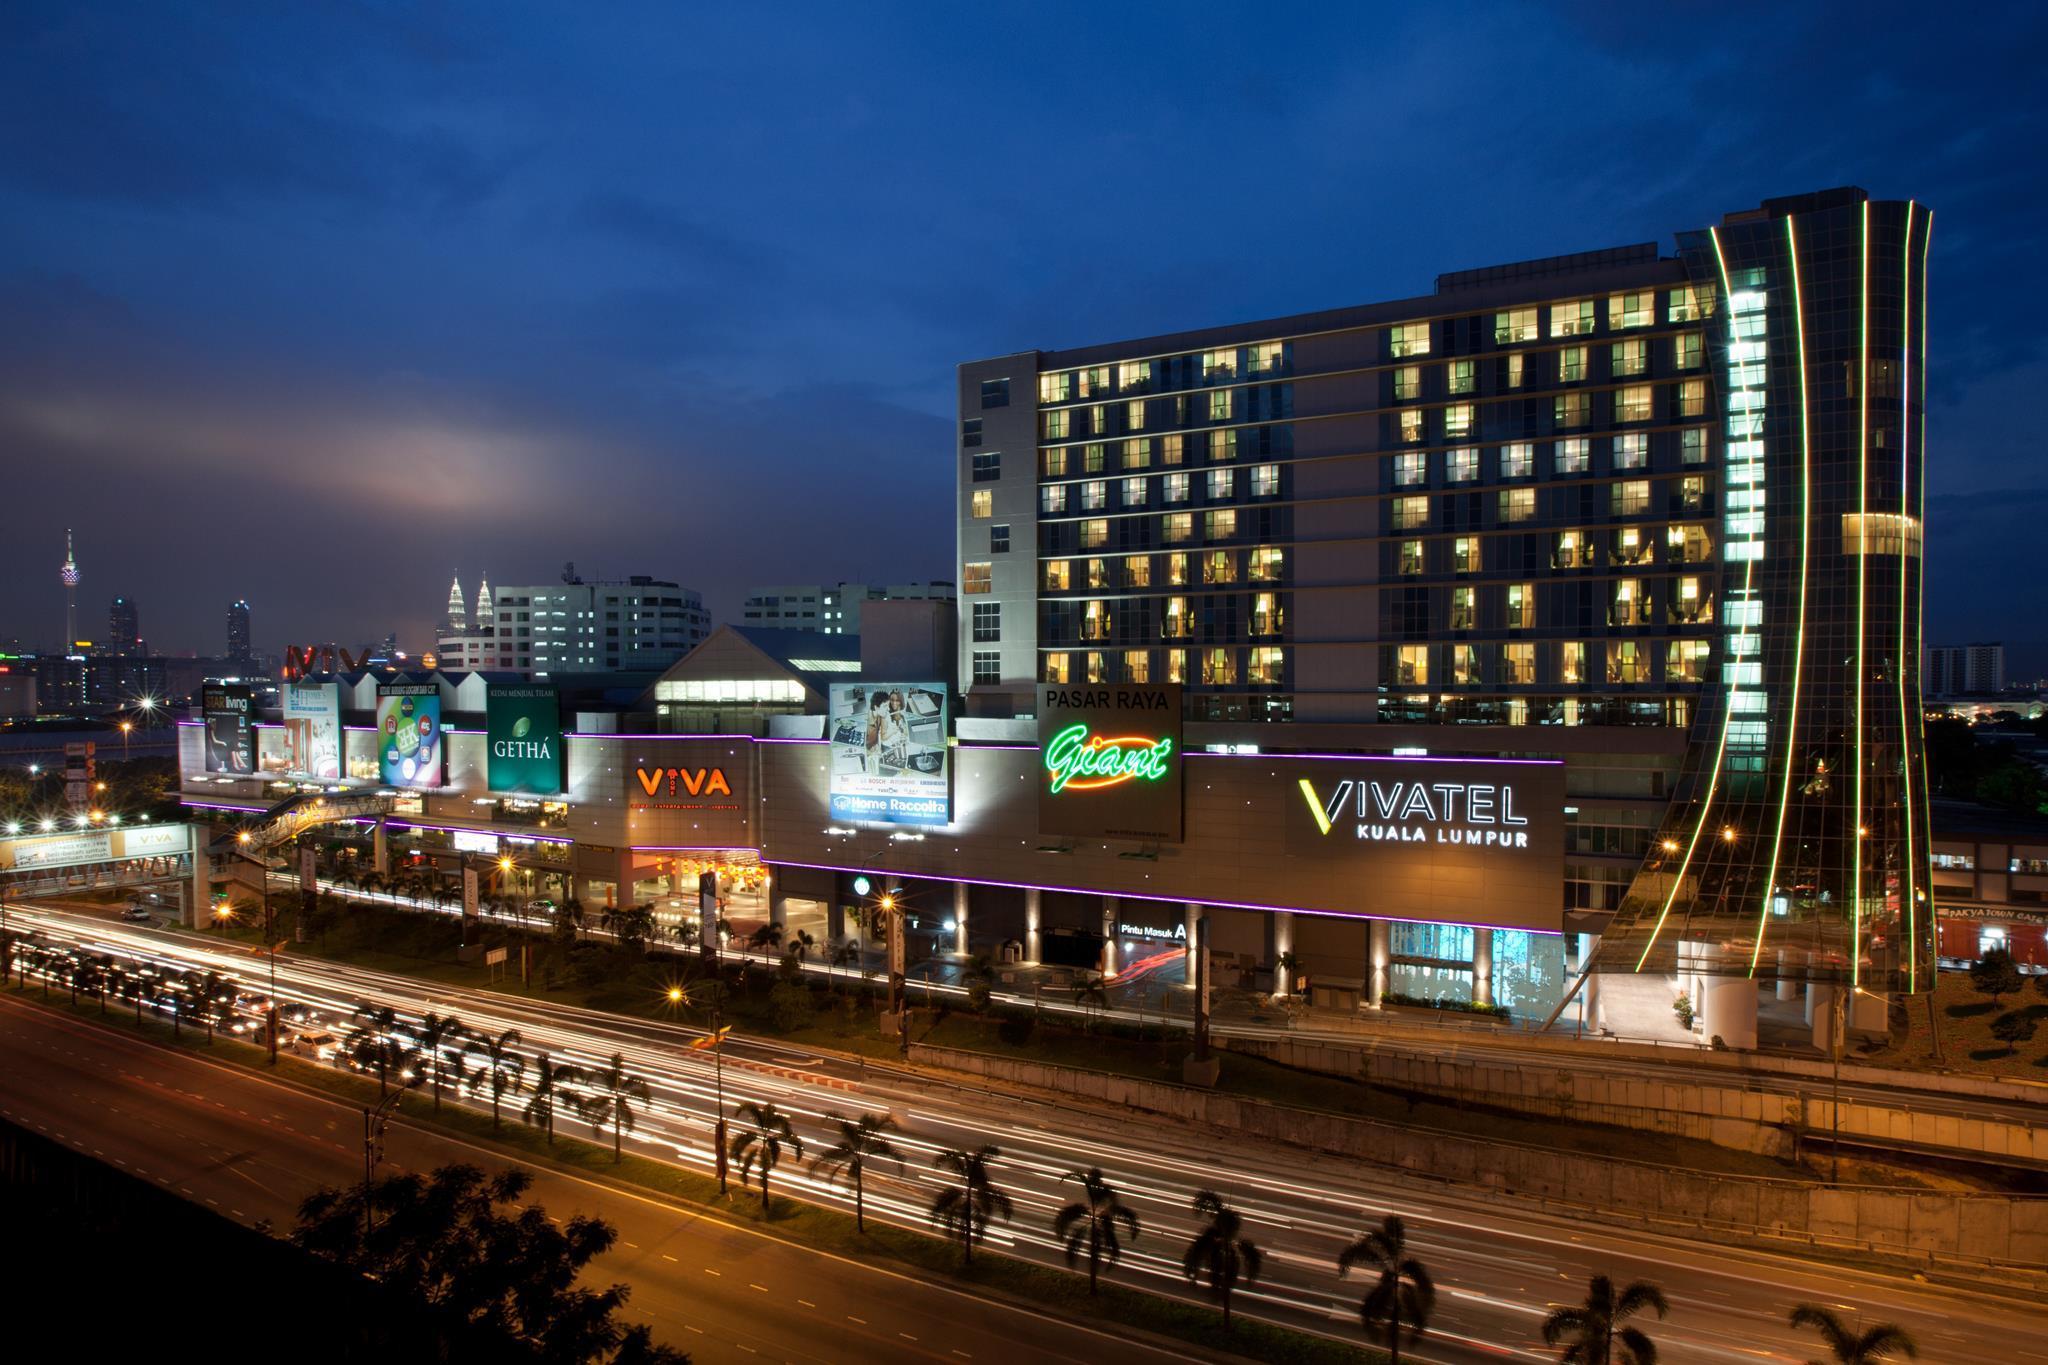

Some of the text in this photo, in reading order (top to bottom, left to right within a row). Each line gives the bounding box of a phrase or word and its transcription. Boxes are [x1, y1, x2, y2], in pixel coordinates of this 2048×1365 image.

[225, 695, 248, 712] living
[1046, 690, 1169, 710] PASAR RAYA
[494, 736, 551, 759] GETHÁ
[1046, 725, 1171, 794] Giant
[851, 796, 887, 810] Home
[1298, 779, 1528, 835] VIVATEL
[1357, 823, 1528, 848] KUALA LUMPUR
[1121, 923, 1187, 939] Pintu Masuk A
